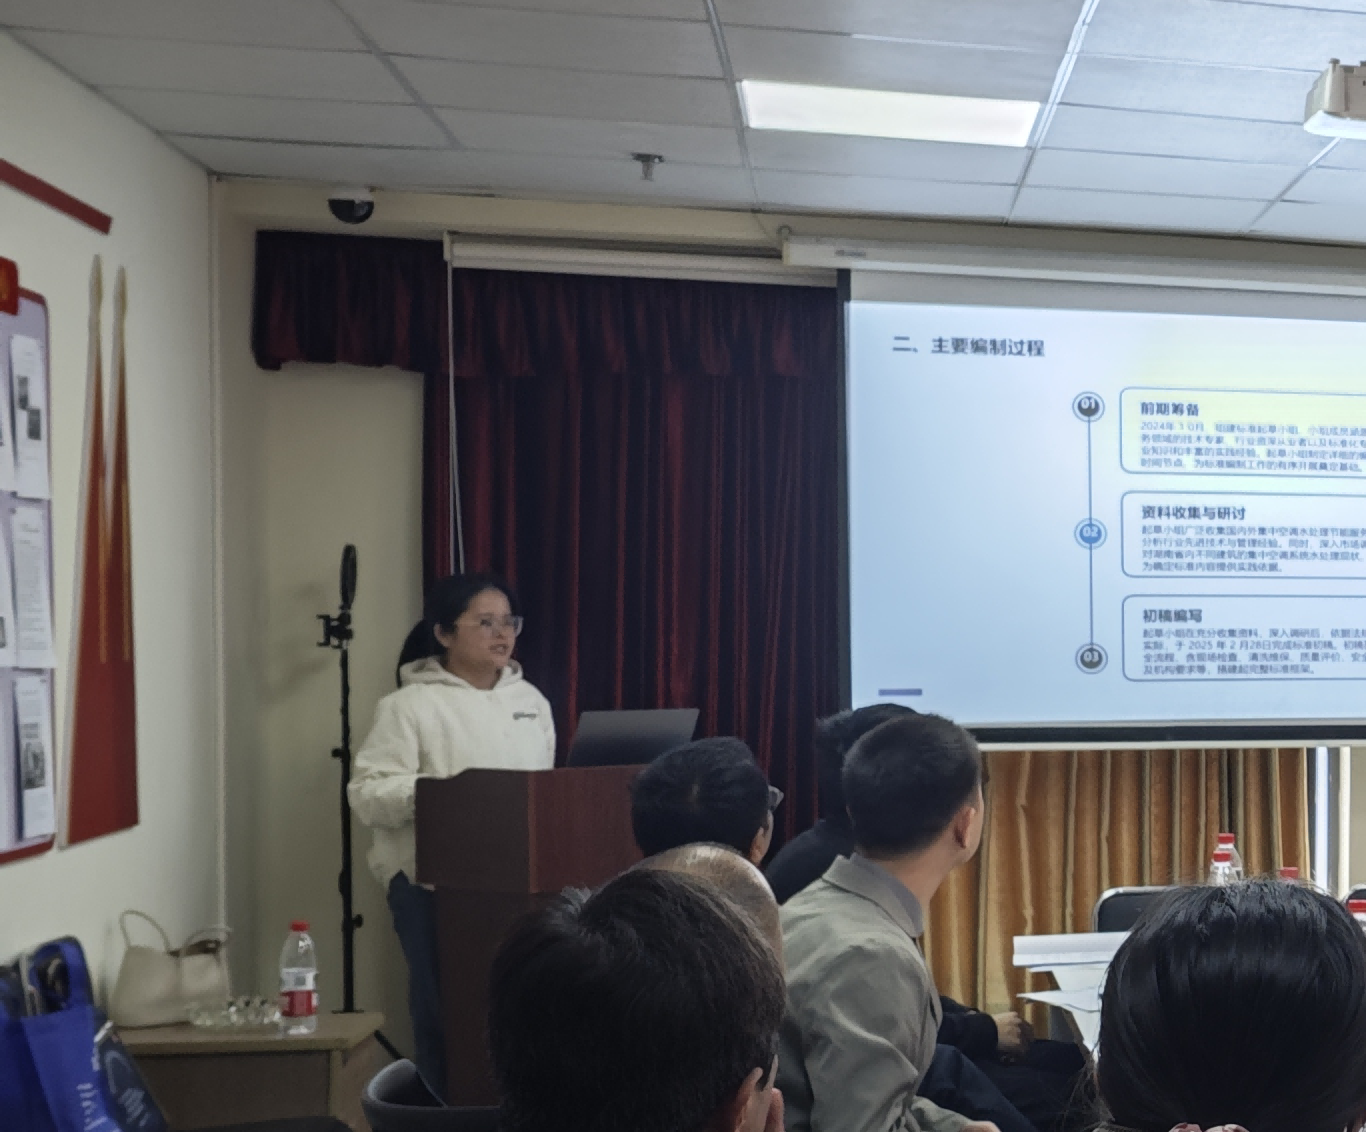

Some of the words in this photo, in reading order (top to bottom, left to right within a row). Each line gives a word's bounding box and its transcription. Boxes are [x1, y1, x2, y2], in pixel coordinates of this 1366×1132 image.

[892, 336, 1045, 357] 二、主要编制过程
[1081, 400, 1096, 409] 01
[1142, 505, 1246, 520] 资料收集与研讨
[1082, 526, 1098, 537] 02
[1143, 609, 1203, 623] 初稿编写
[1083, 652, 1099, 661] 03
